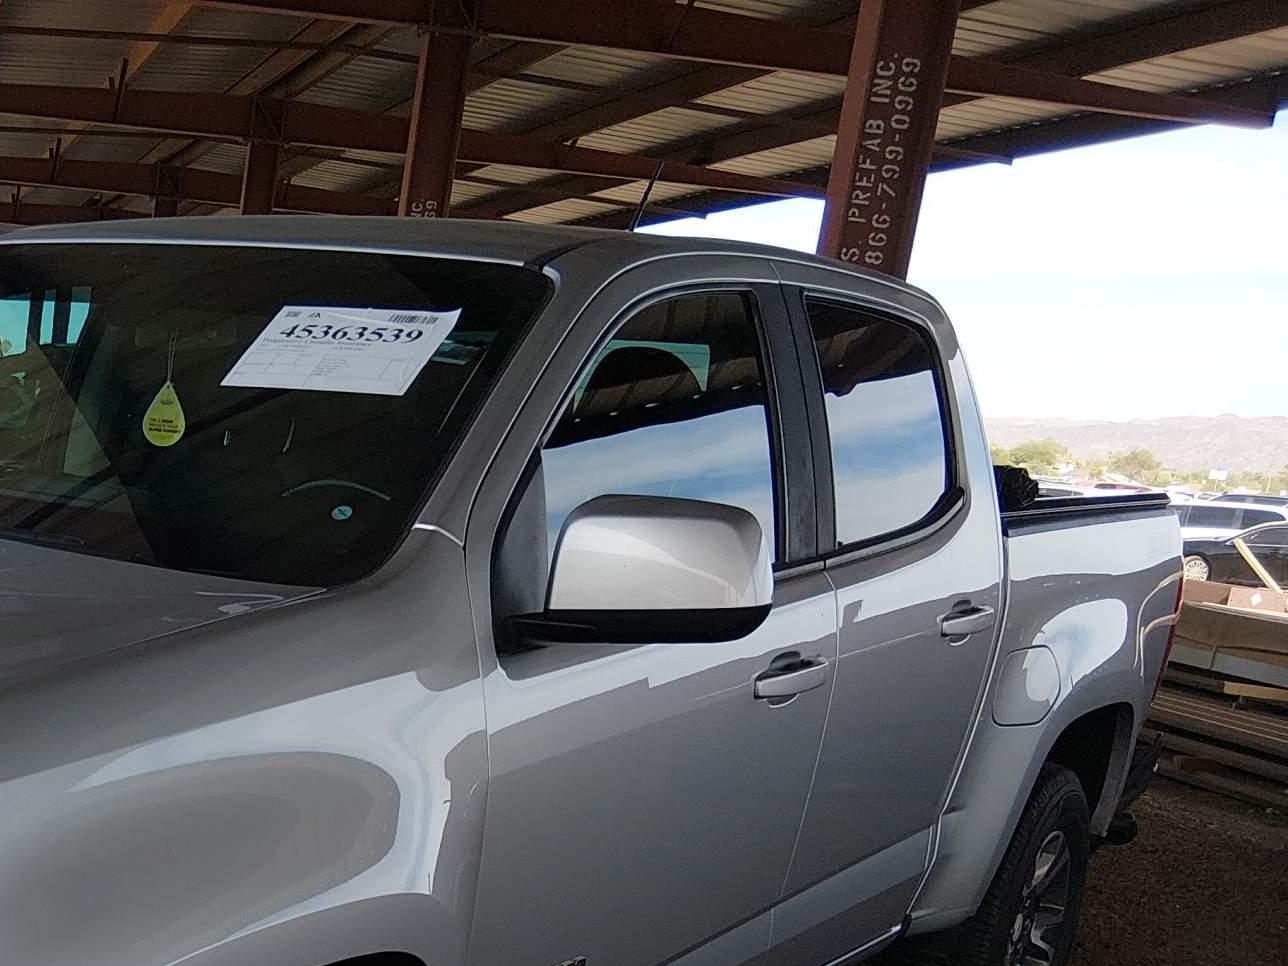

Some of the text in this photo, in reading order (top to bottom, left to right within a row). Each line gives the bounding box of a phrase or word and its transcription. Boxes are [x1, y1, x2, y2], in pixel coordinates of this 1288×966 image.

[848, 118, 885, 223] PREFAB
[870, 53, 899, 104] INC.
[864, 56, 921, 265] 866-799-0969
[279, 322, 424, 345] 45363539
